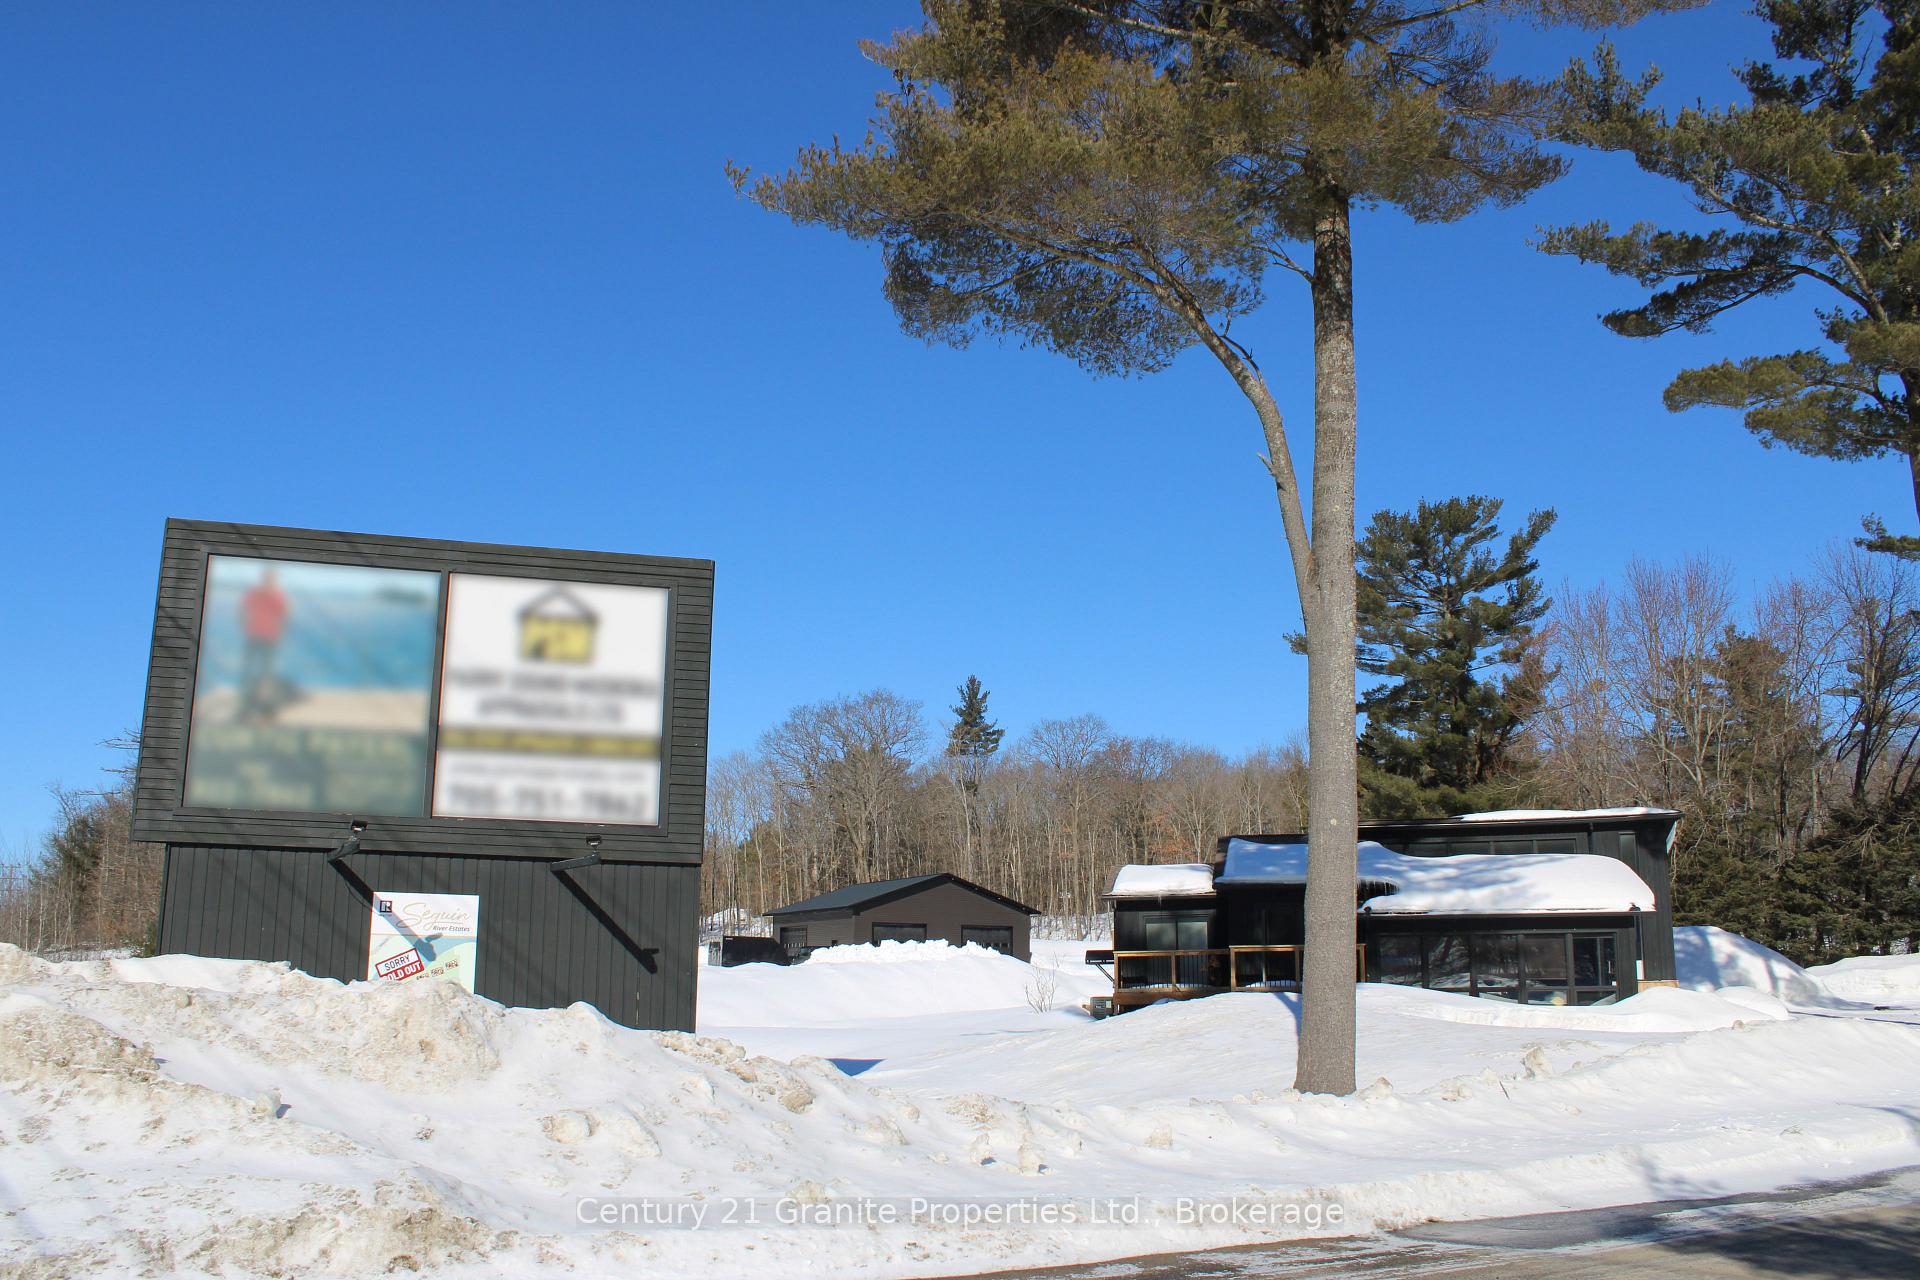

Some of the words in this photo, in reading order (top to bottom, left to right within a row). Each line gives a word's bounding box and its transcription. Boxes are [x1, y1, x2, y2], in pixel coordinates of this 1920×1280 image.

[396, 902, 470, 931] Seguin
[384, 954, 410, 971] SORRY
[384, 967, 405, 981] OLD
[404, 962, 421, 975] OUT
